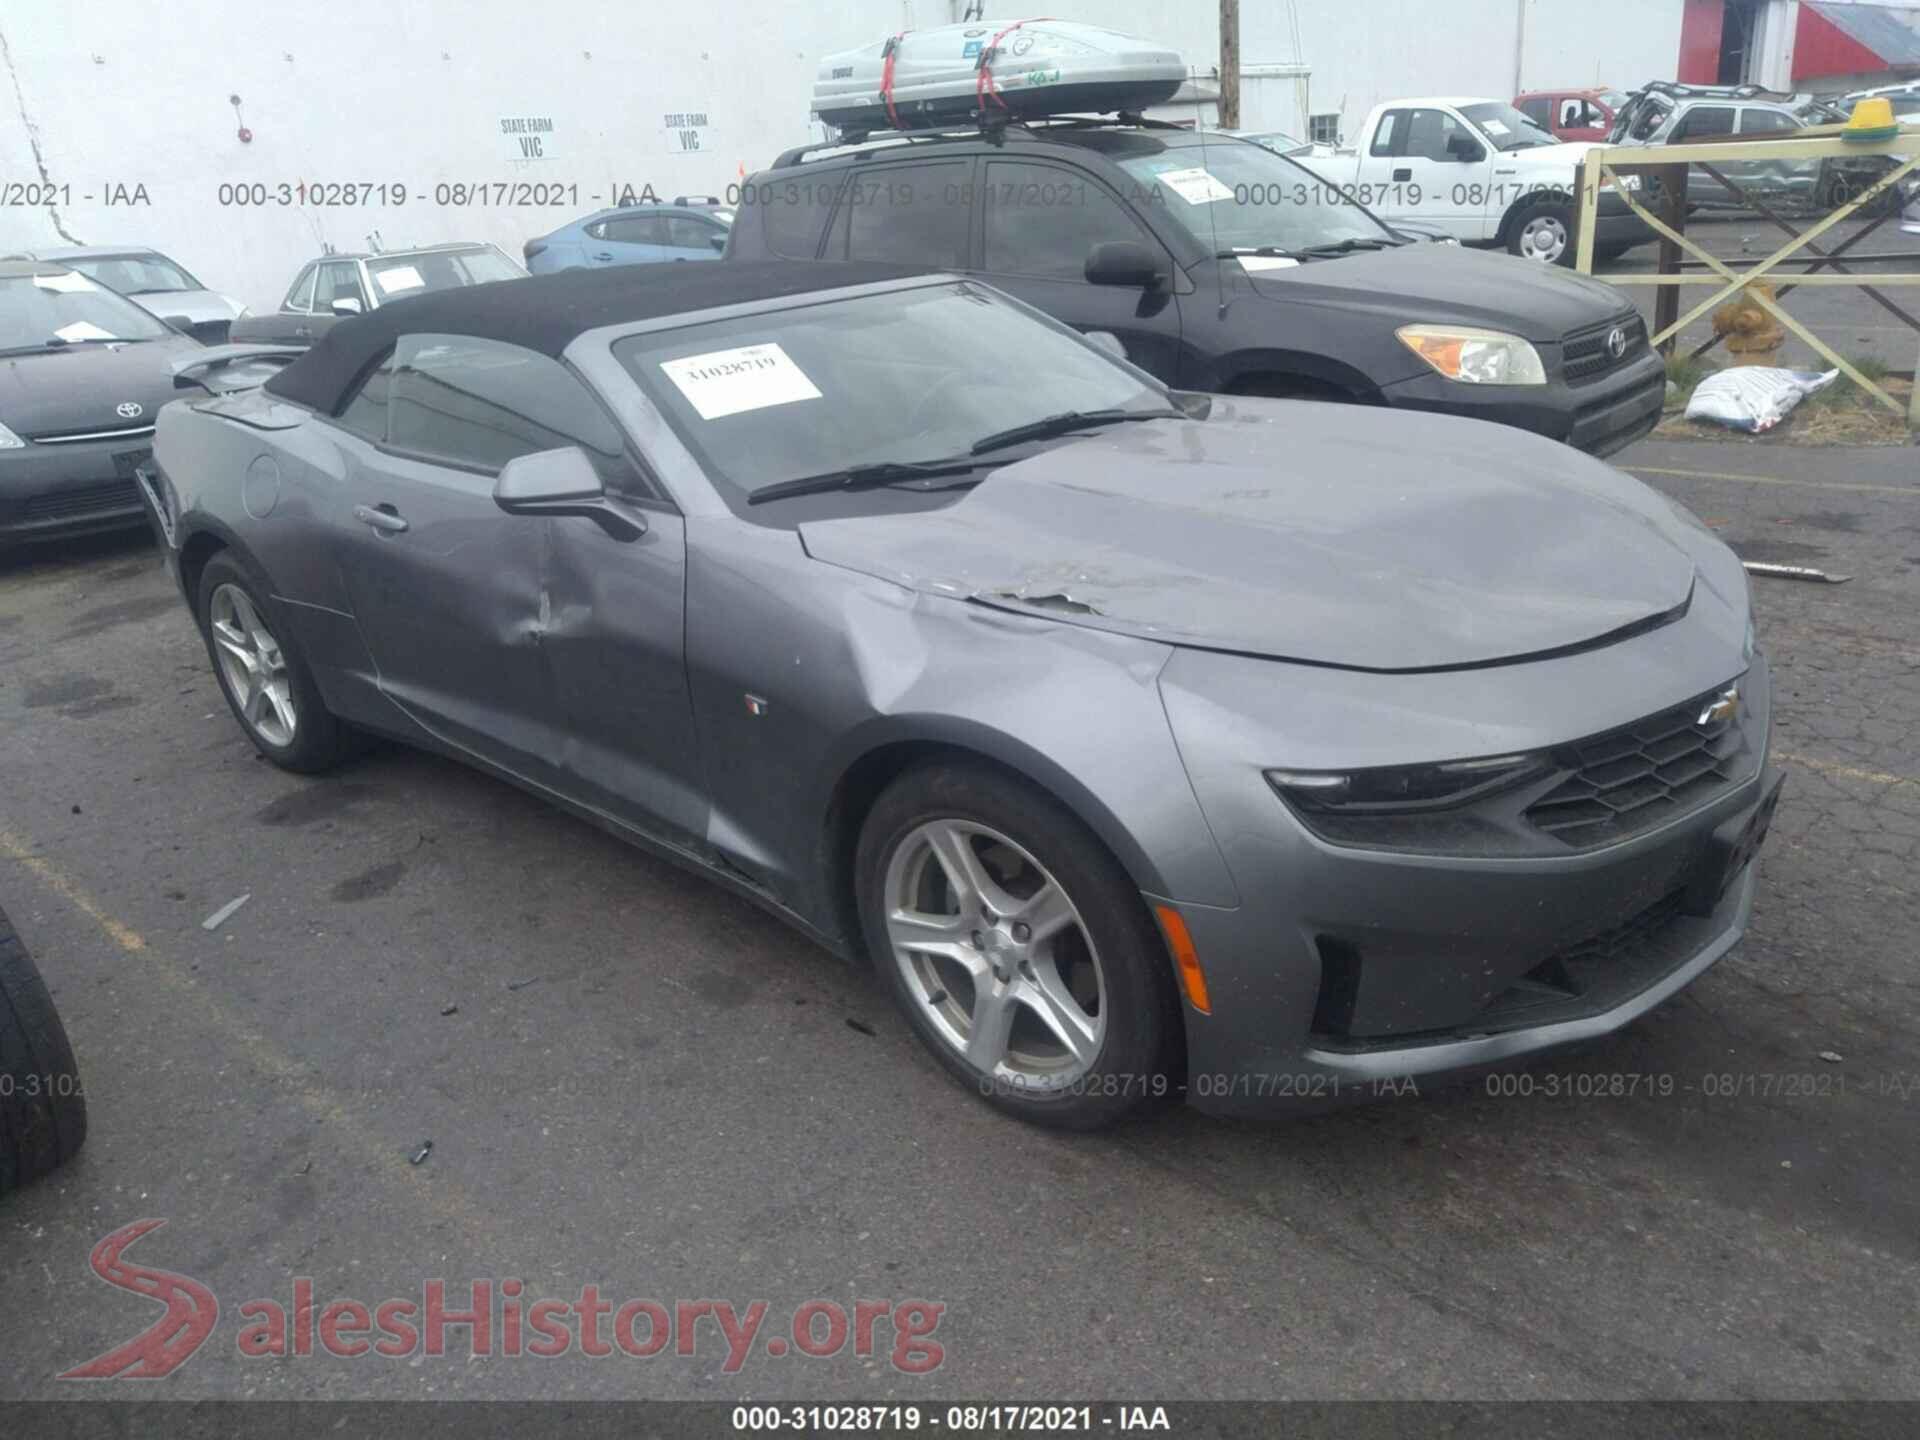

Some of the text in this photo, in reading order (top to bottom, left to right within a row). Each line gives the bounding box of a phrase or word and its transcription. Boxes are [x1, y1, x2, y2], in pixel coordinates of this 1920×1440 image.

[501, 117, 552, 134] STATE FARM
[664, 113, 707, 128] STATE FARM
[520, 136, 543, 158] VIC
[679, 130, 699, 150] VIC
